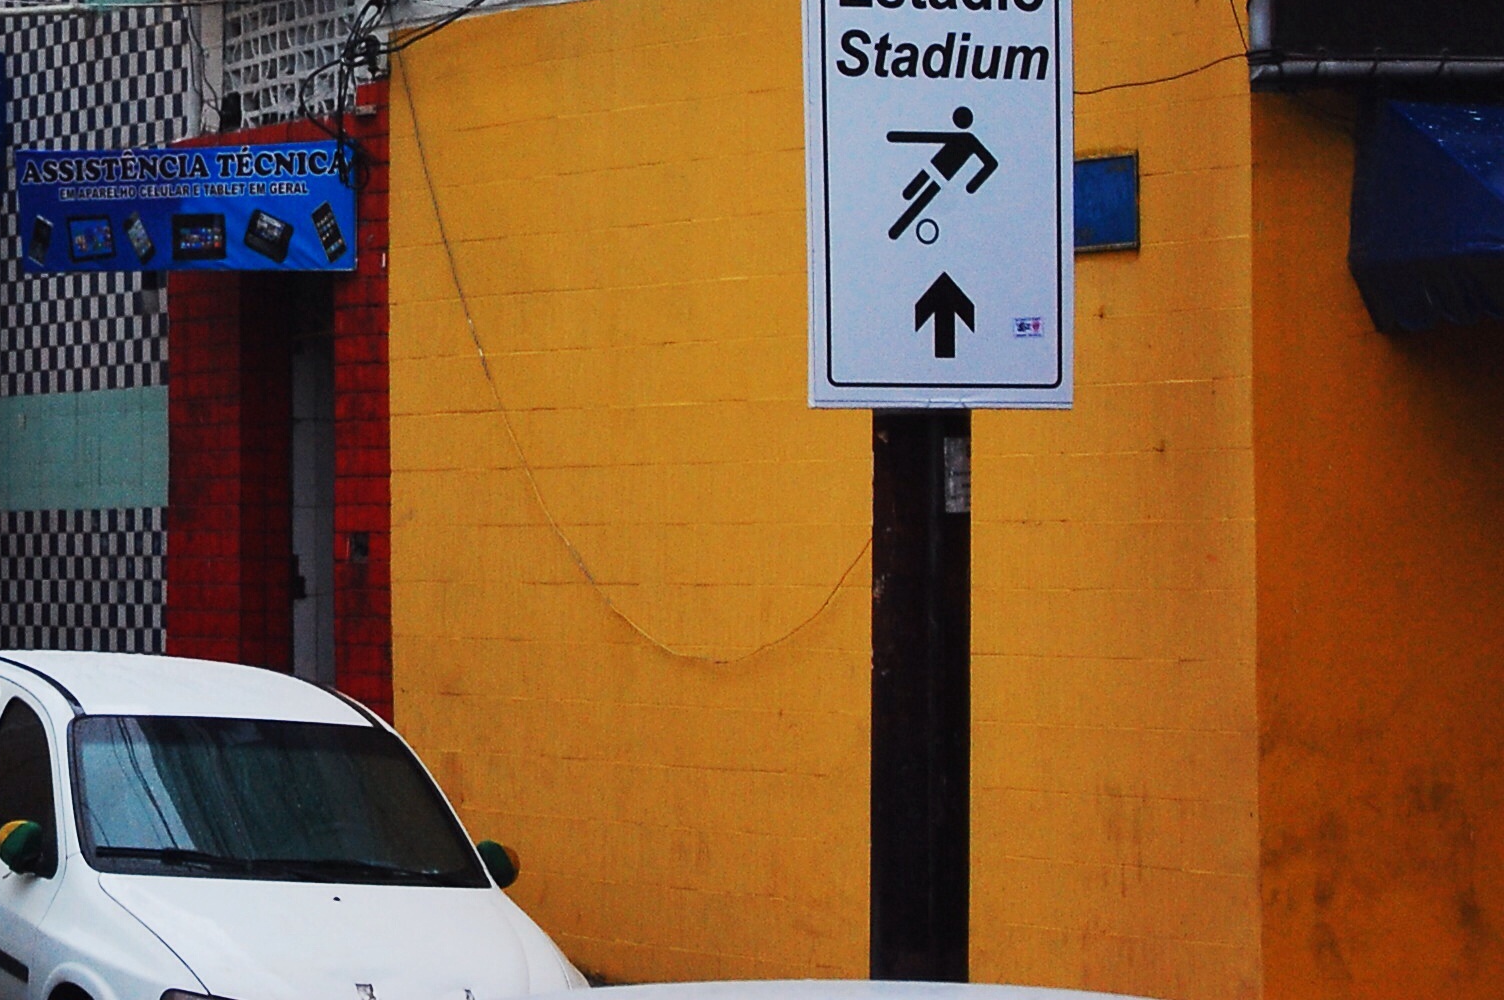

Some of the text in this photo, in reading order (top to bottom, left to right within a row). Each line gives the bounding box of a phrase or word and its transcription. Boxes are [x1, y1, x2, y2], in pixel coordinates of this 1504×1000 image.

[836, 29, 1050, 81] Stadium
[20, 145, 349, 185] ASSISTÊNCIA TÉCNICA
[59, 180, 310, 200] EM APARELHO CELULAR E TABLET EM GERAL
